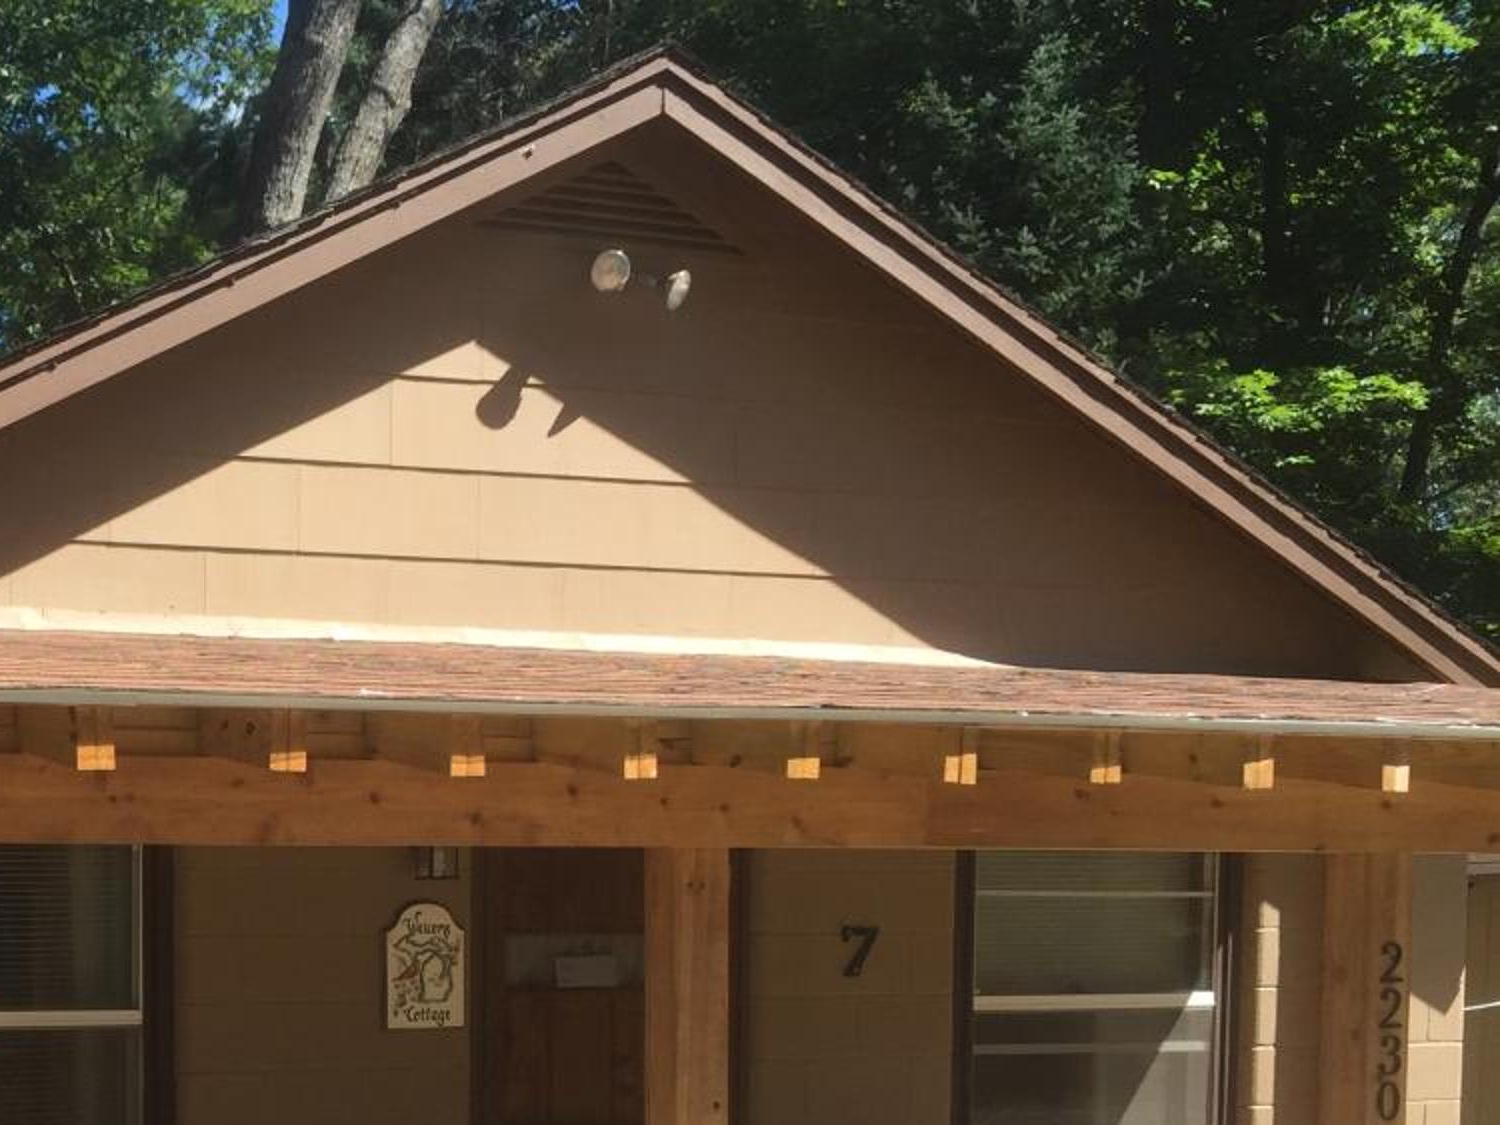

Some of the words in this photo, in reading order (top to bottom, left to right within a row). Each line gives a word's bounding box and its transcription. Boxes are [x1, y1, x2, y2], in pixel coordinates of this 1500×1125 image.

[840, 925, 880, 978] 7
[403, 1005, 452, 1028] Cottage
[1376, 940, 1404, 1121] 2230
